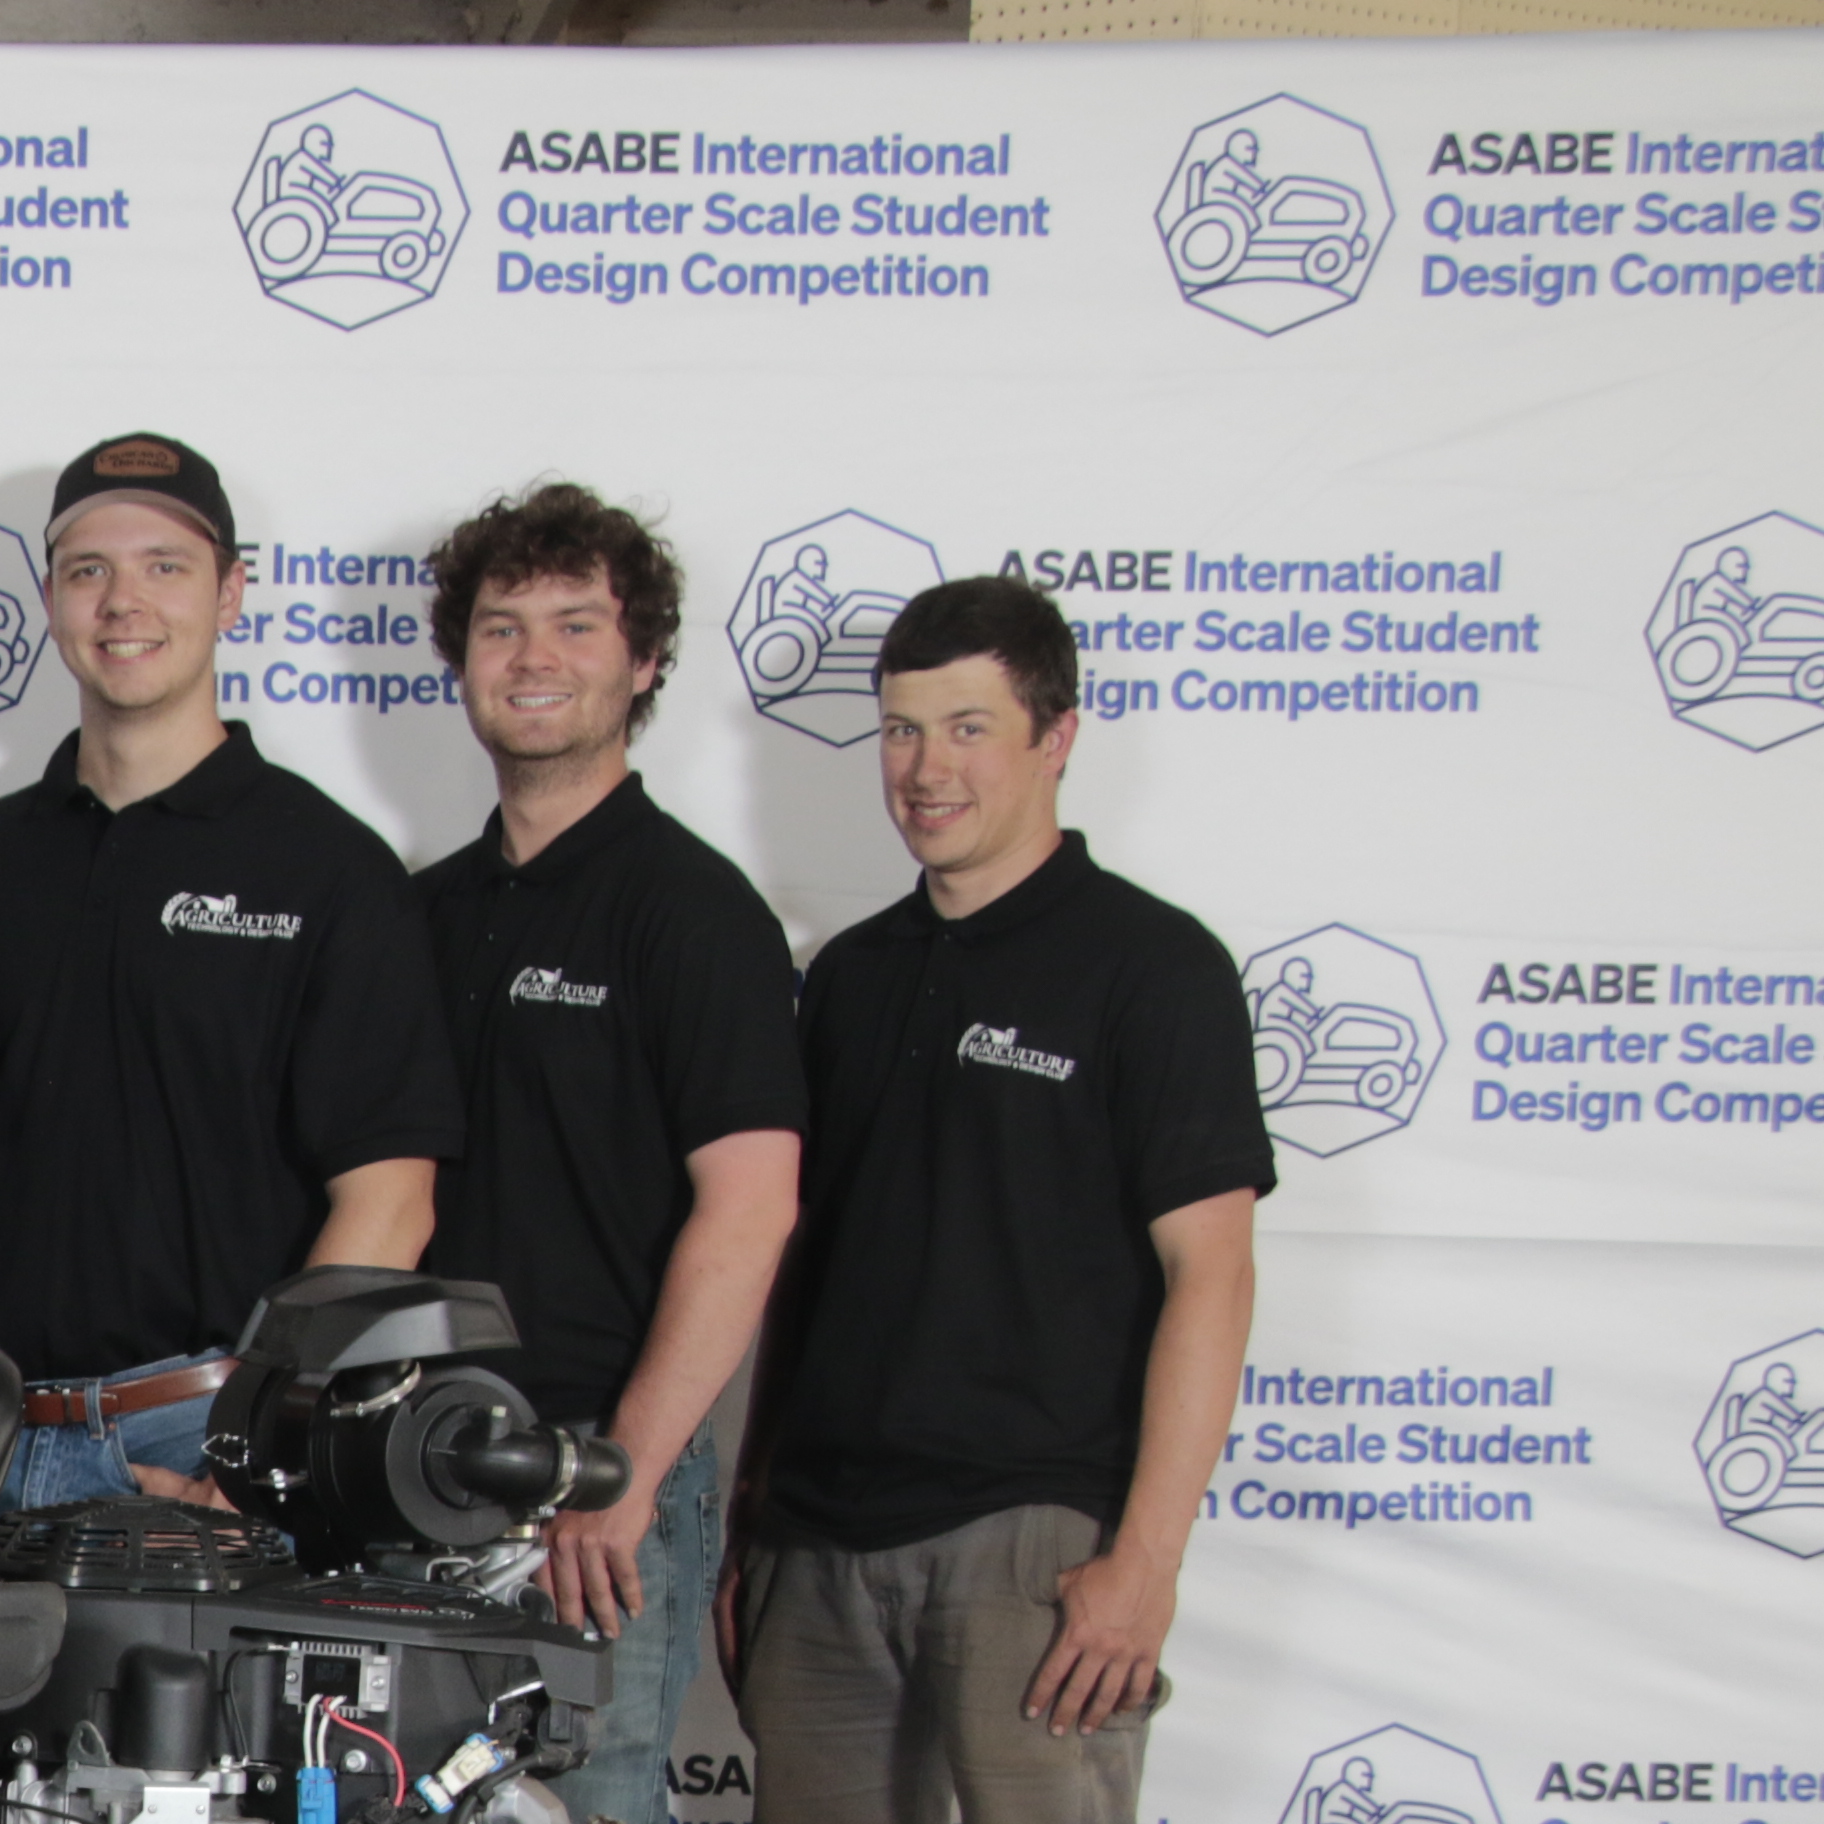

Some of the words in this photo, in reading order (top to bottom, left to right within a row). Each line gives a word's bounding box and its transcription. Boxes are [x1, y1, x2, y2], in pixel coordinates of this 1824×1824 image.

[500, 131, 680, 174] ASABE
[694, 133, 1009, 175] International
[498, 191, 693, 239] Quarter
[704, 193, 840, 235] Scale
[851, 194, 1049, 236] Student
[498, 252, 667, 304] Design
[682, 253, 988, 305] Competition
[171, 908, 302, 933] AGRICULTURE
[1478, 963, 1658, 1004] ASABE
[1476, 1022, 1668, 1068] Quarter
[1680, 1023, 1814, 1064] Scale
[1473, 1081, 1641, 1131] Design
